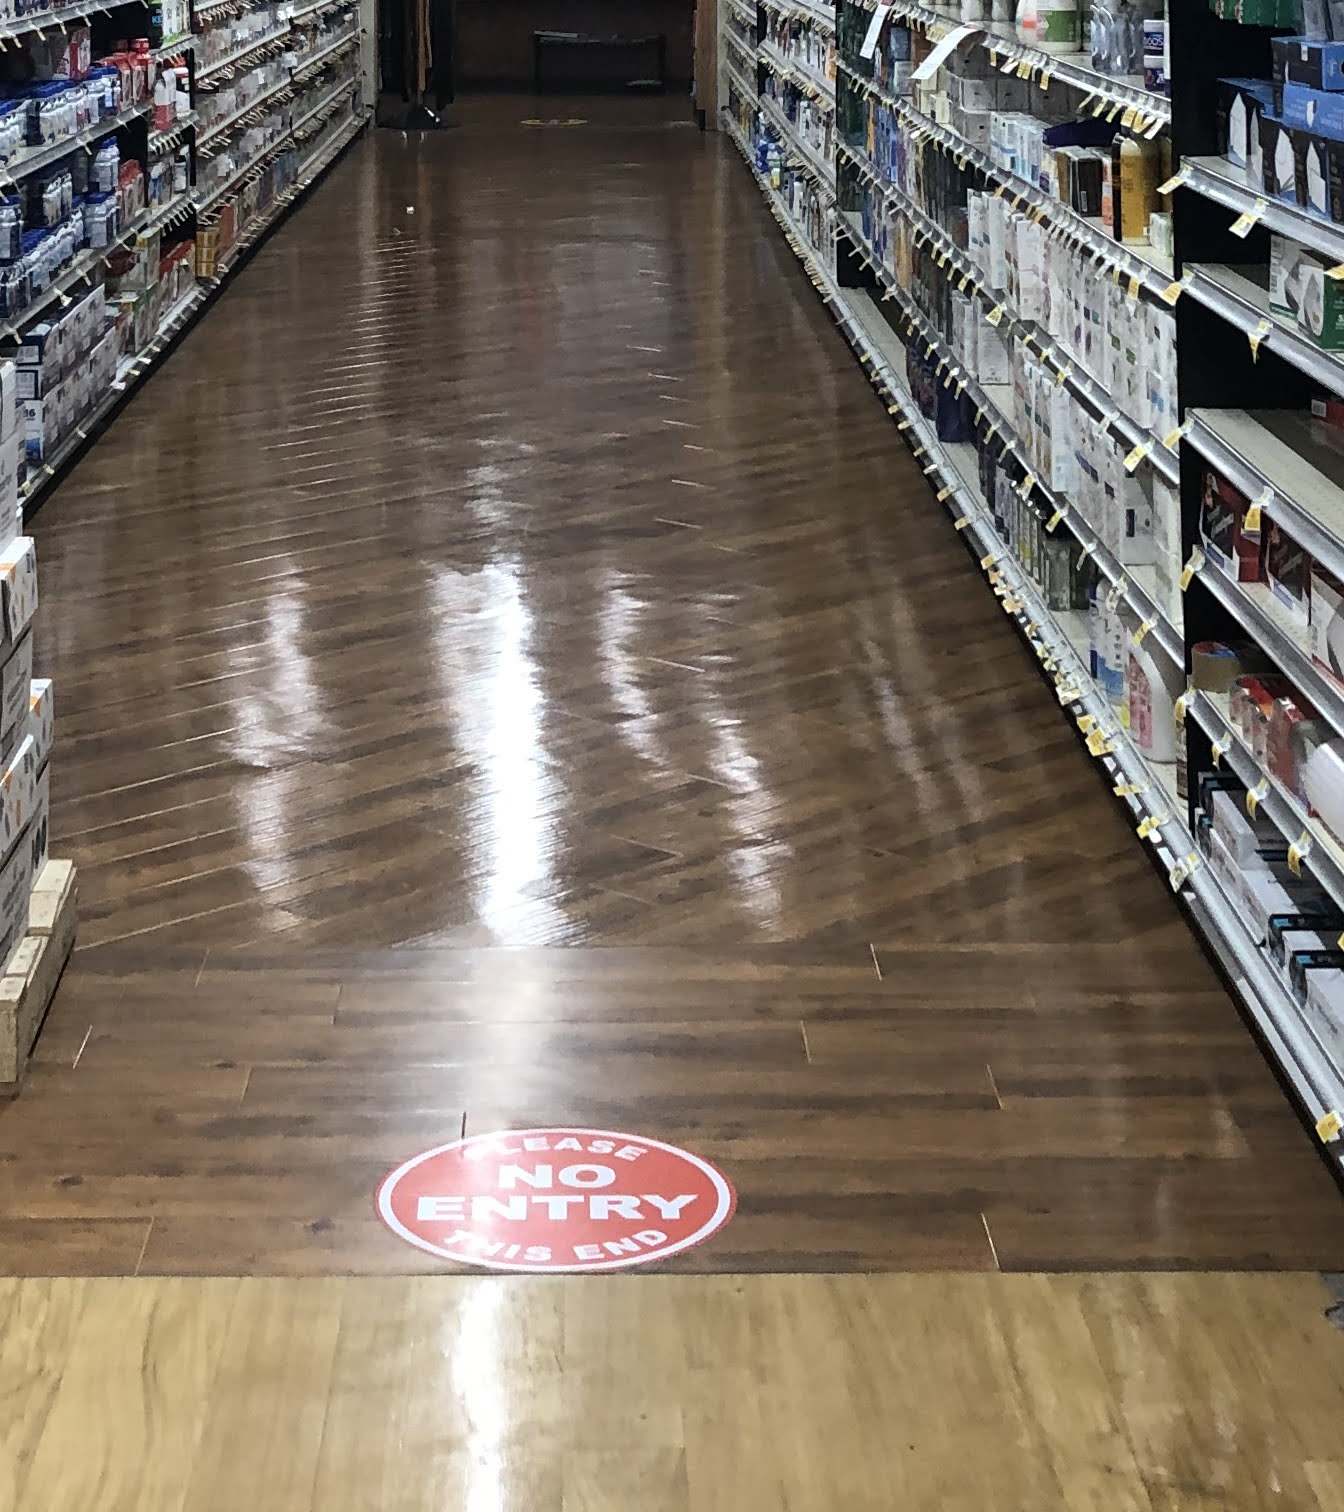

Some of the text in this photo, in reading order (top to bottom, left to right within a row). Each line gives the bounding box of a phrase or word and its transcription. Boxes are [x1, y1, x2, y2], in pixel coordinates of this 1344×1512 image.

[497, 1163, 616, 1189] NO
[416, 1194, 699, 1221] ENTRY
[573, 1228, 669, 1262] END
